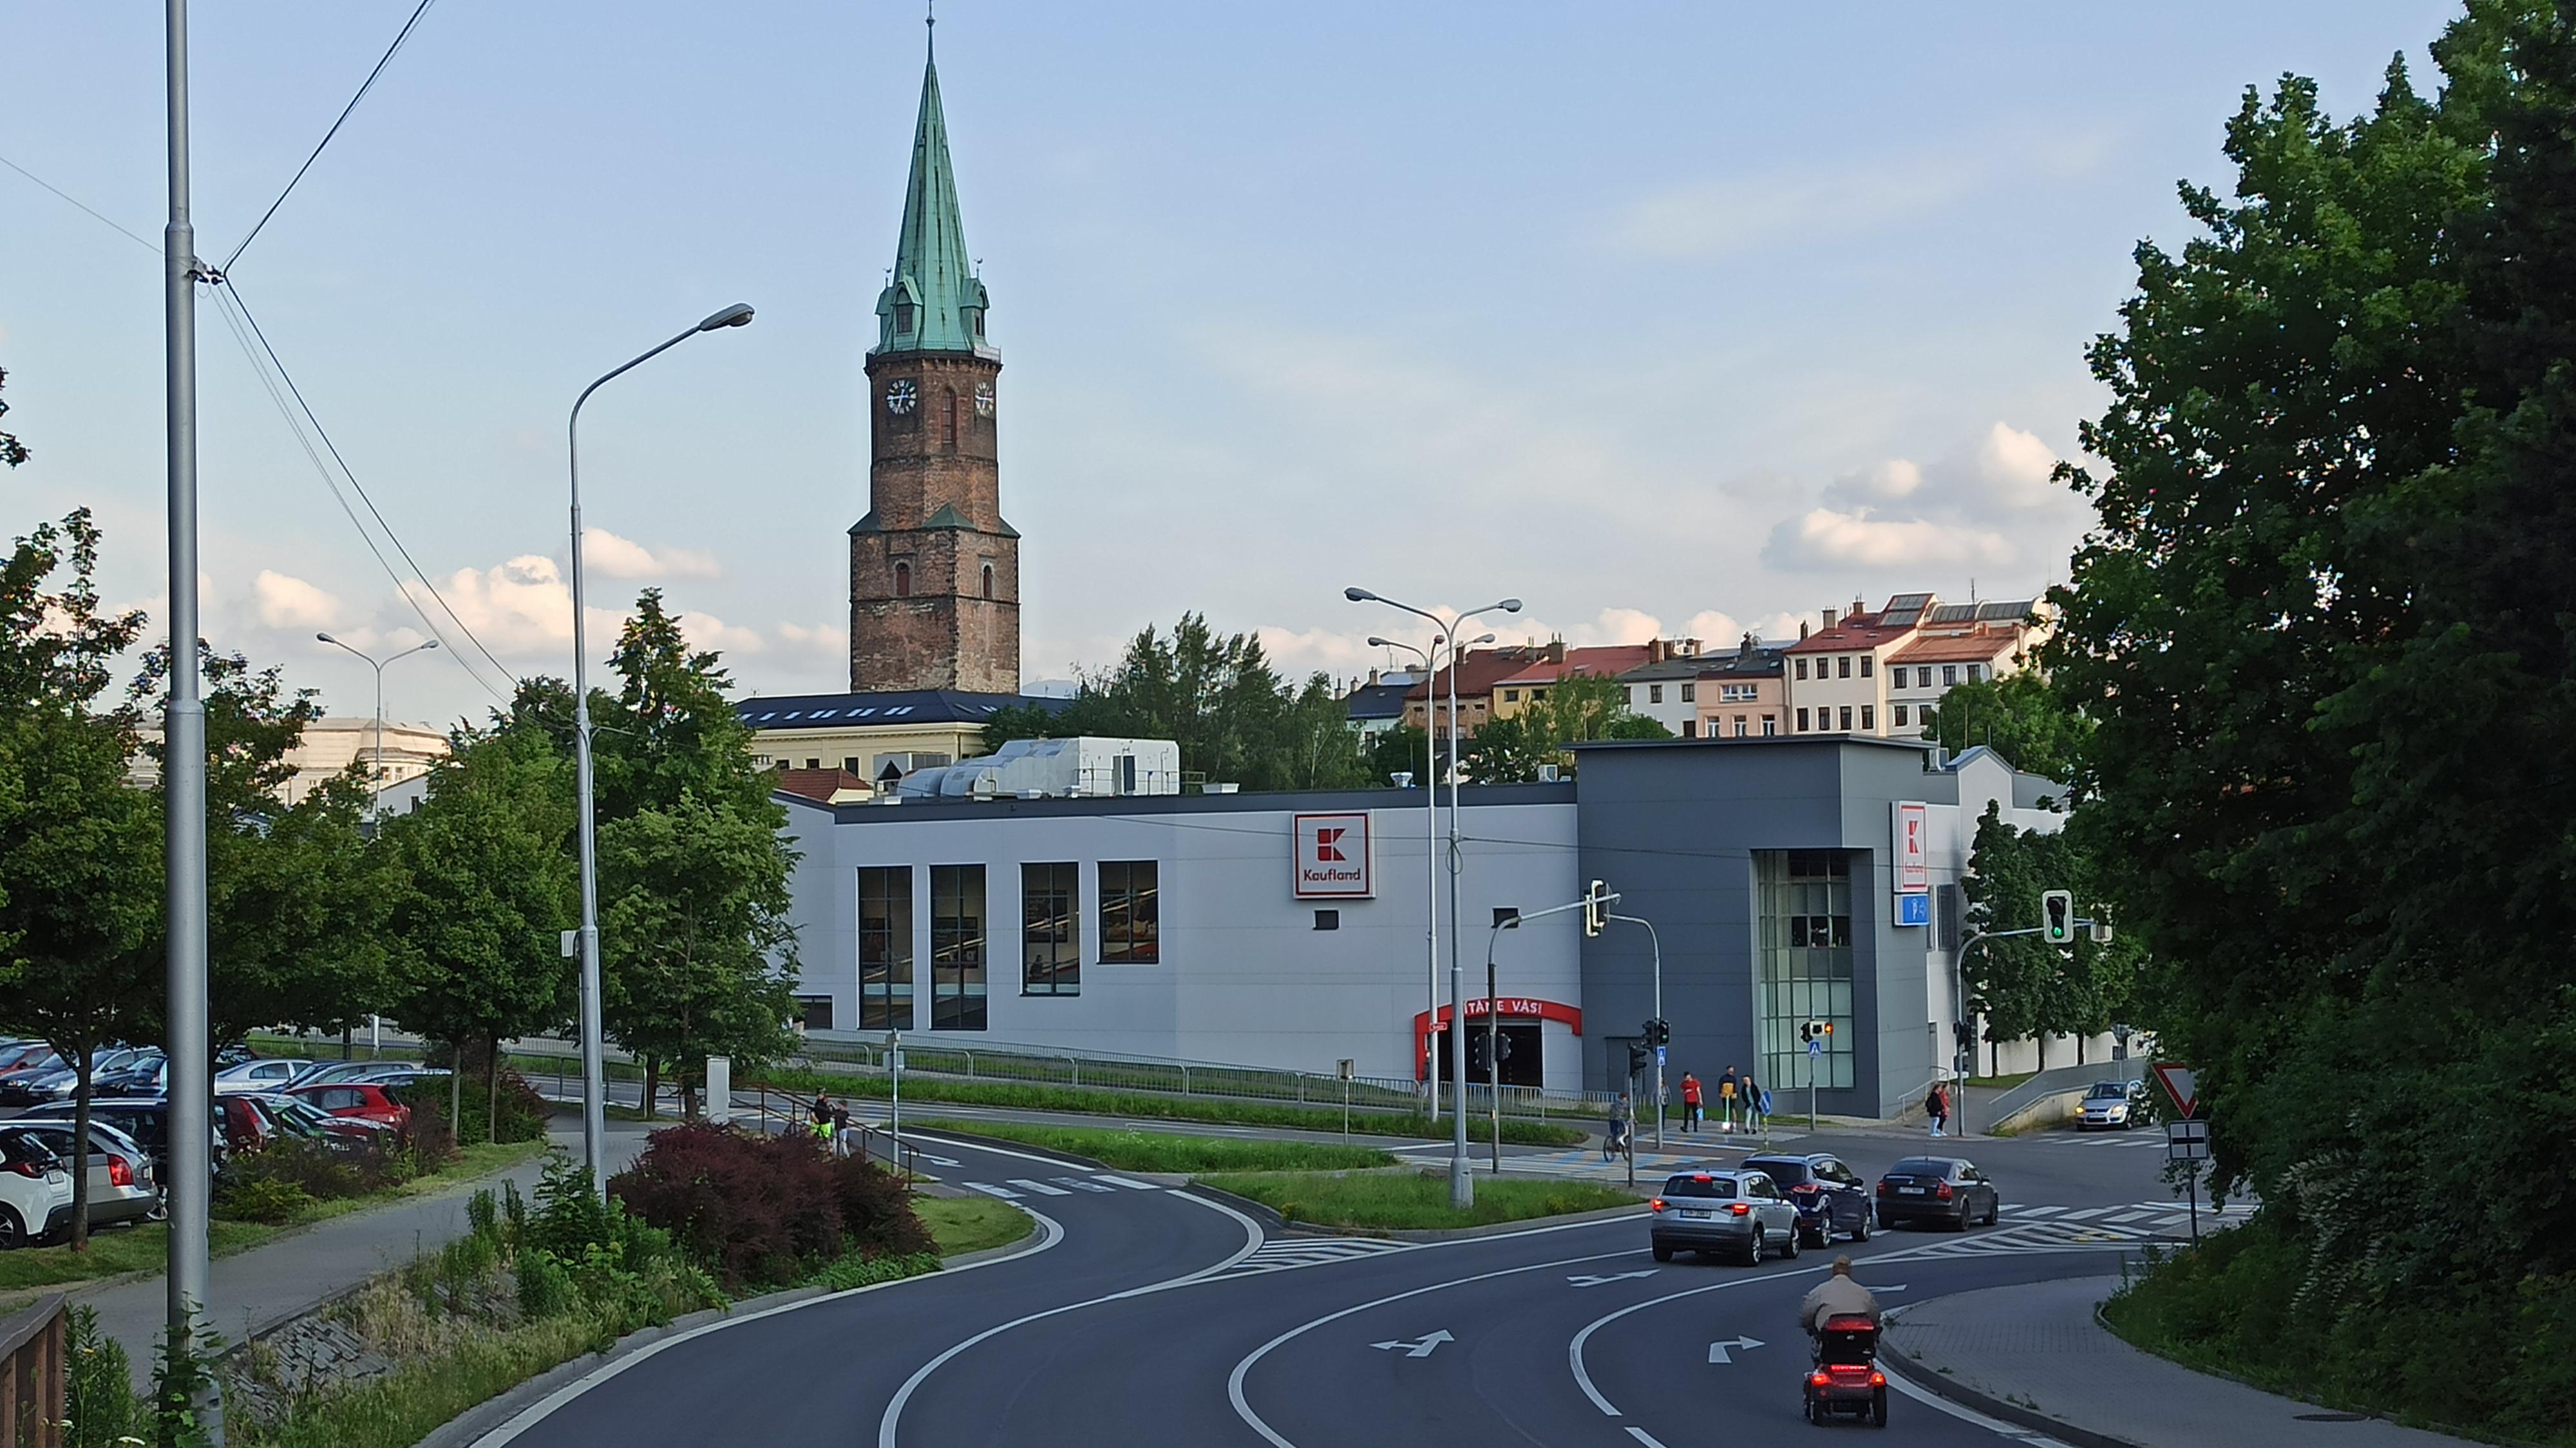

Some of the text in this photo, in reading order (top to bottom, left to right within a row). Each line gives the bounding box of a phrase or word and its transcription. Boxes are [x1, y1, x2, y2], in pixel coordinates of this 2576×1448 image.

[1317, 828, 1347, 861] K
[1303, 867, 1361, 881] Kaufland
[1511, 999, 1542, 1015] VÁS!
